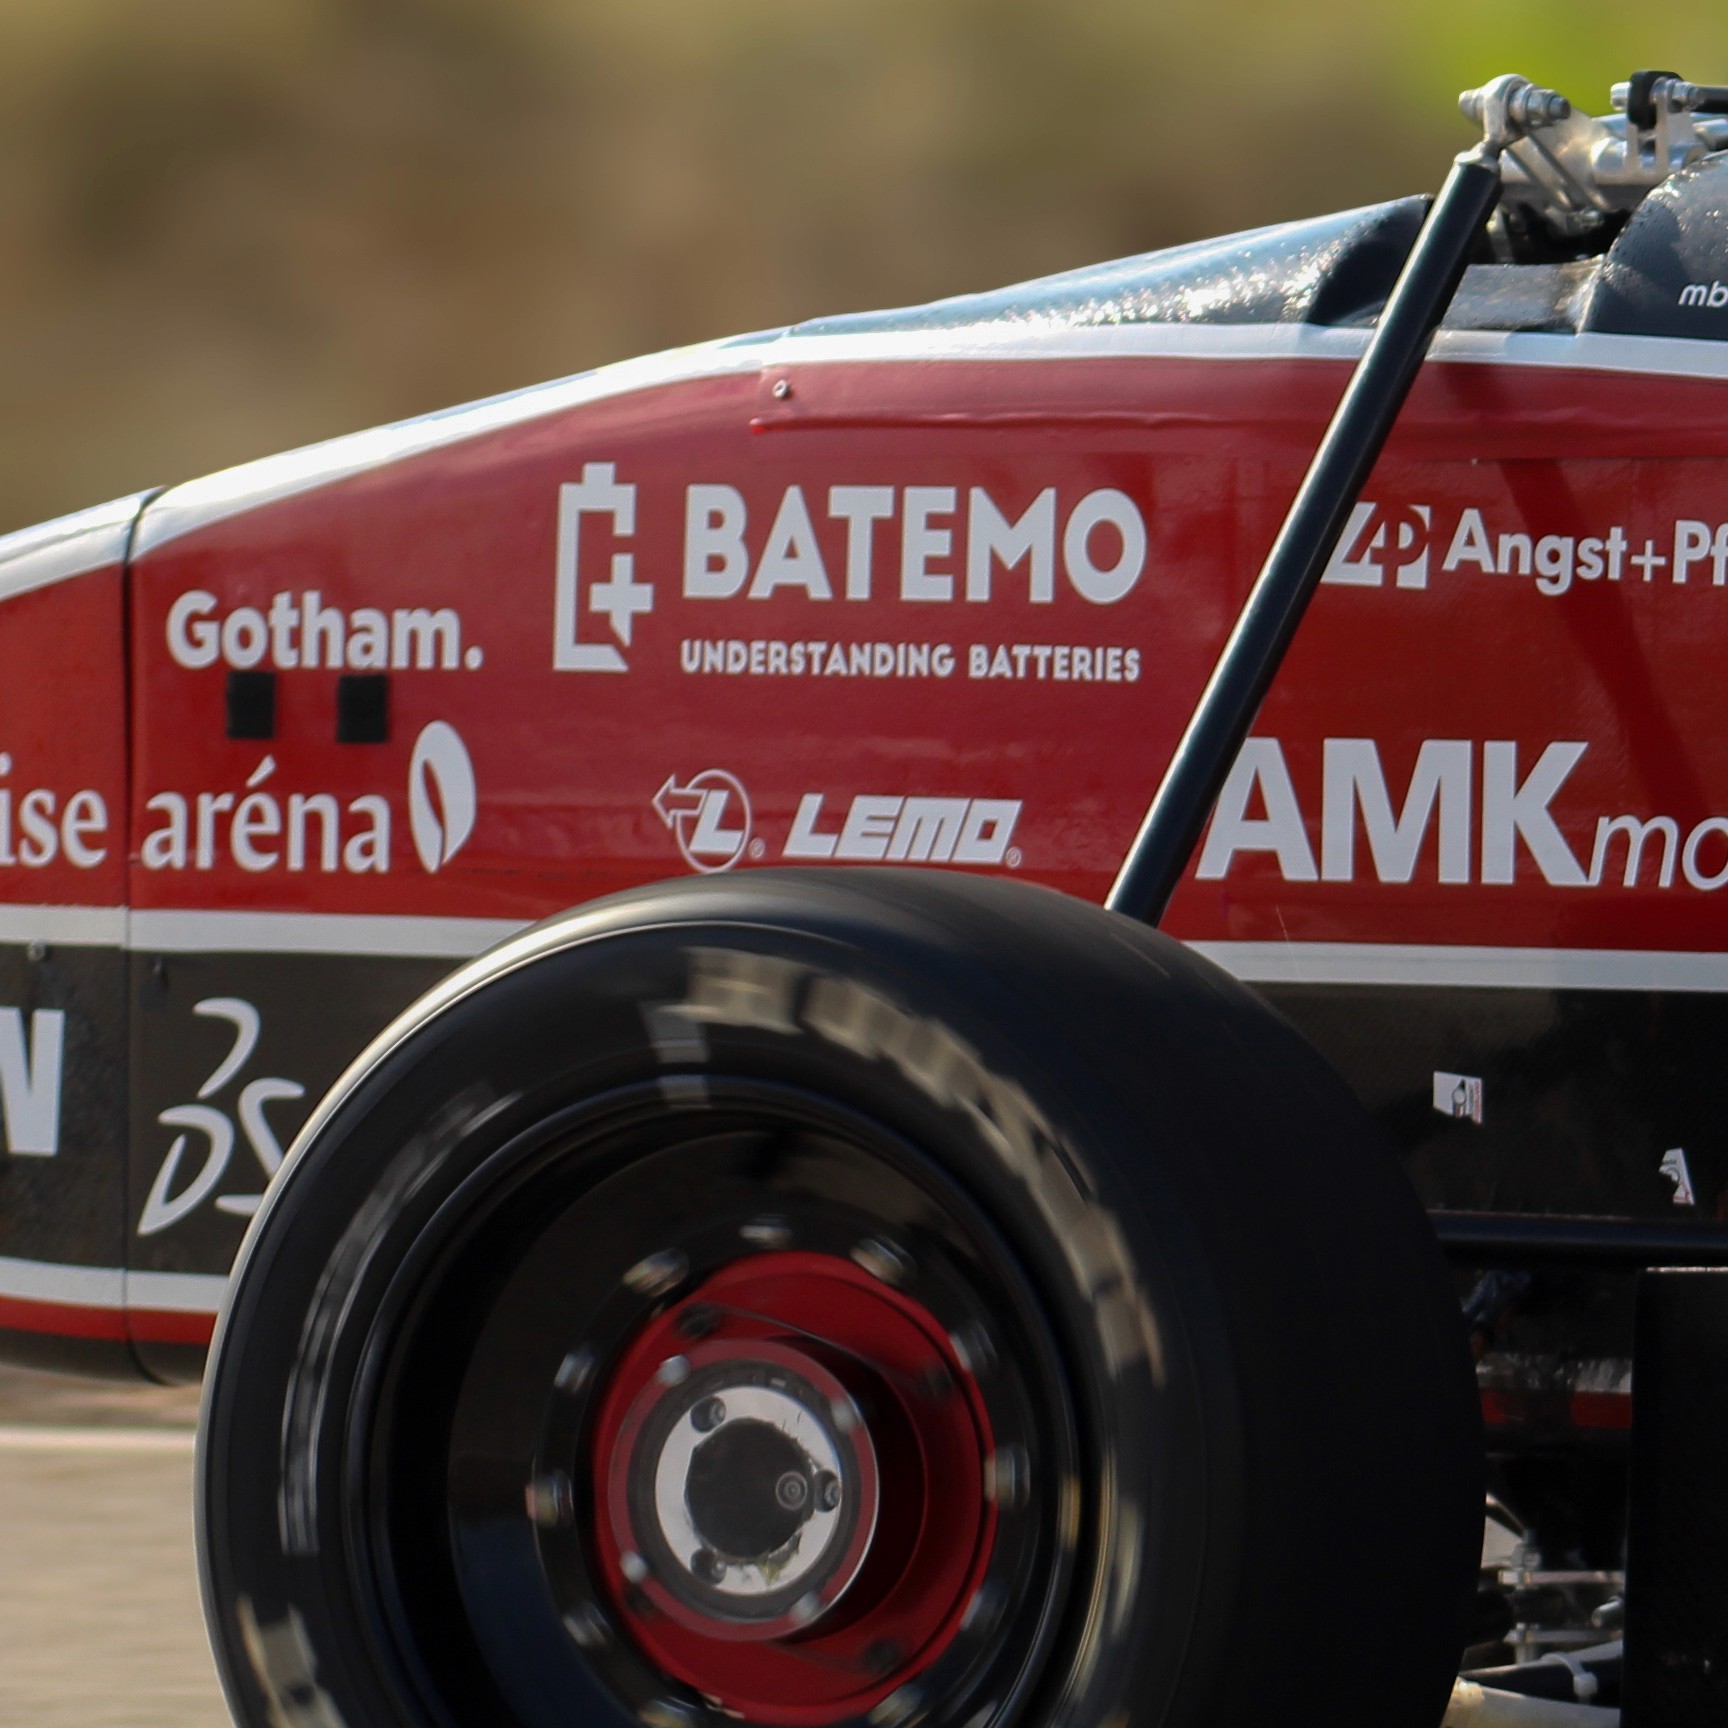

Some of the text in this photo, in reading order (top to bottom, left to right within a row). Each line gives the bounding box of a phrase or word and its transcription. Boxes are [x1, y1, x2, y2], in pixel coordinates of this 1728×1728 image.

[683, 484, 1147, 604] BATEMO
[167, 590, 484, 670] Gotham.
[681, 639, 1142, 682] UNDERSTANDING BATTERIES
[140, 755, 391, 873] aréna
